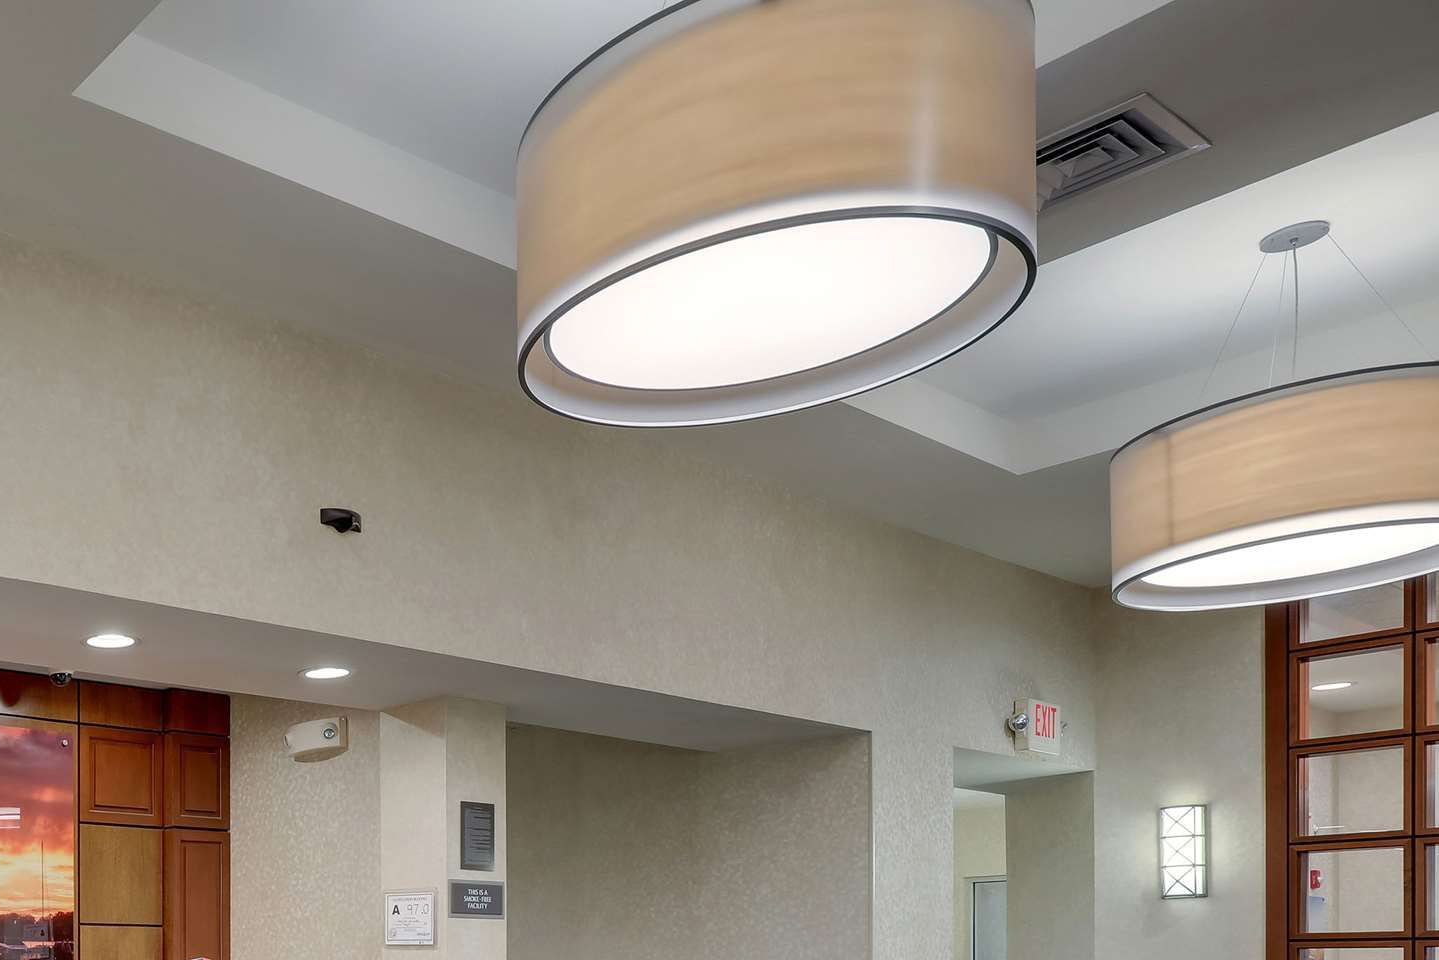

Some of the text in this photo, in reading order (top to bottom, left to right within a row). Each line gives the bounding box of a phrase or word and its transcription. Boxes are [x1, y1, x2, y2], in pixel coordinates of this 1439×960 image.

[1035, 703, 1057, 739] EXIT
[392, 903, 430, 915] A 97.0
